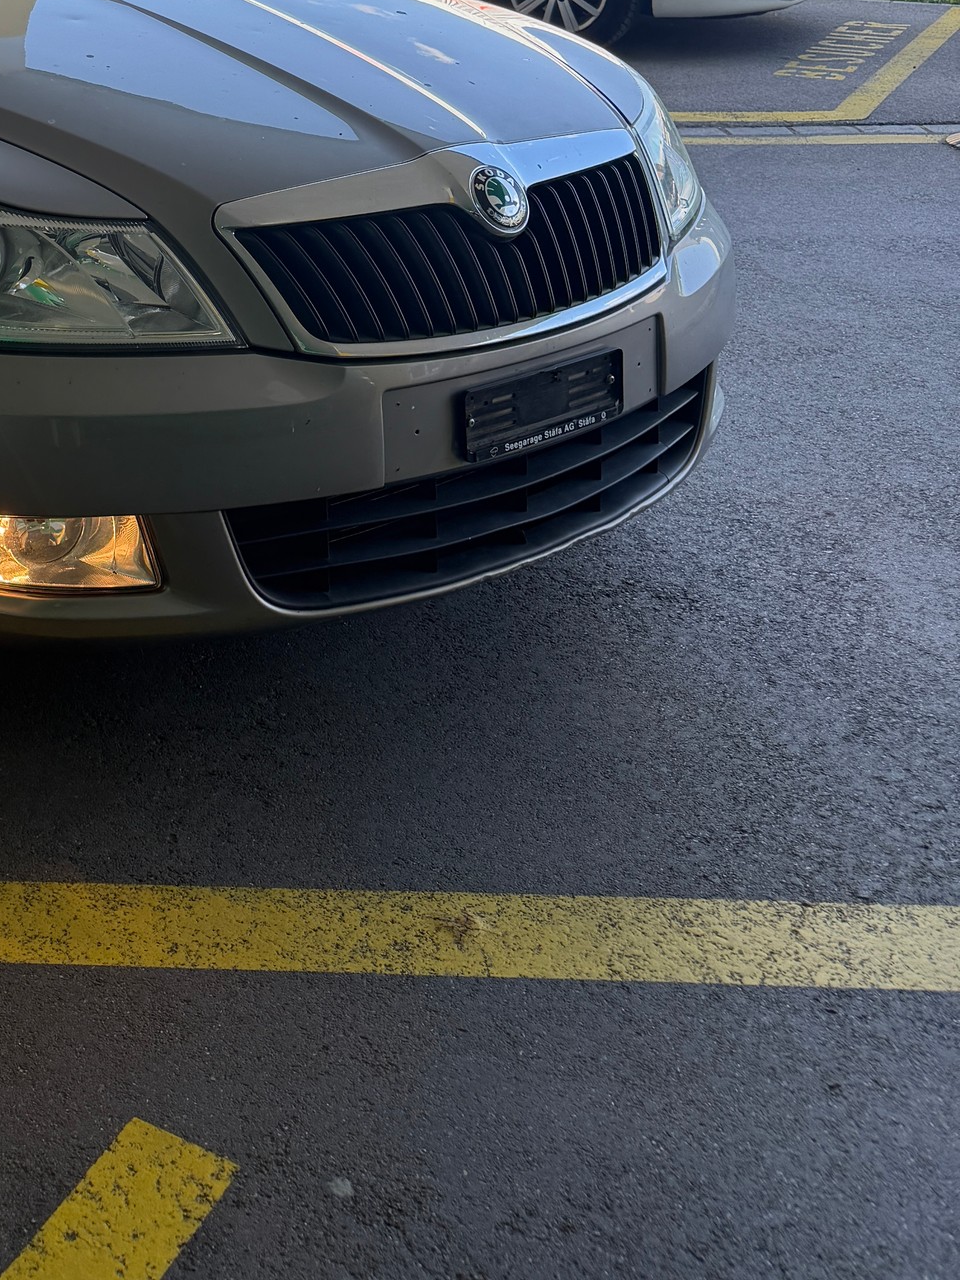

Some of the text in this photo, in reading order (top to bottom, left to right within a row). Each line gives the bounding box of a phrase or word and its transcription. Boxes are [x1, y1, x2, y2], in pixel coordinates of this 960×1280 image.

[773, 21, 911, 81] BESUCHER
[504, 433, 543, 452] Seegarage
[564, 422, 575, 433] AG
